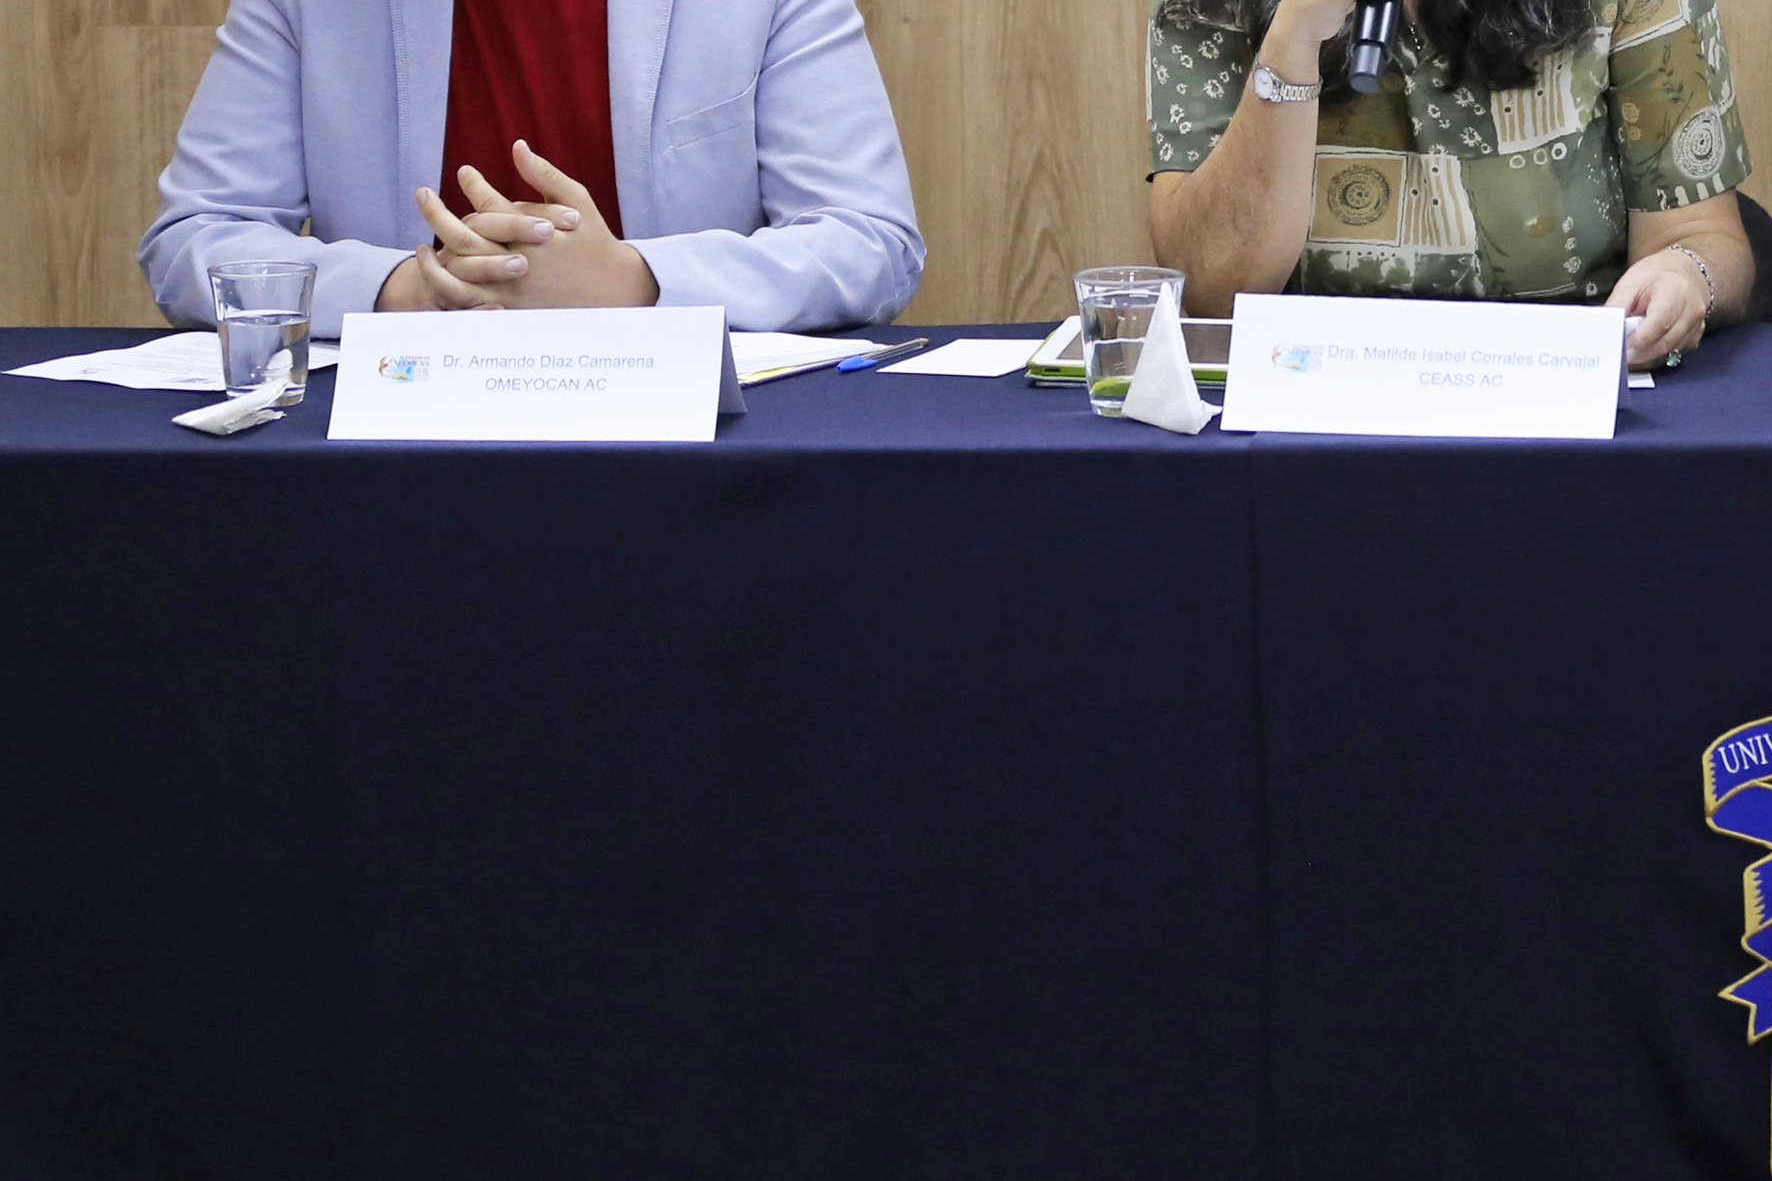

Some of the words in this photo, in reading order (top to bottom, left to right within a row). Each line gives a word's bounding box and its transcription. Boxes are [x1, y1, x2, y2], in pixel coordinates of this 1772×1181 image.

[443, 355, 463, 368] Dr.
[469, 355, 535, 368] Armando
[578, 355, 654, 369] Camarena
[1328, 345, 1358, 359] Dra.
[1364, 347, 1417, 361] Matilde
[1423, 349, 1465, 363] Isabel
[1471, 351, 1533, 365] Corrales
[1539, 353, 1600, 369] Carvajal
[485, 378, 580, 391] OMEYOCAN
[585, 378, 607, 391] AC
[1419, 372, 1475, 386] CEASS
[1480, 374, 1503, 387] AC
